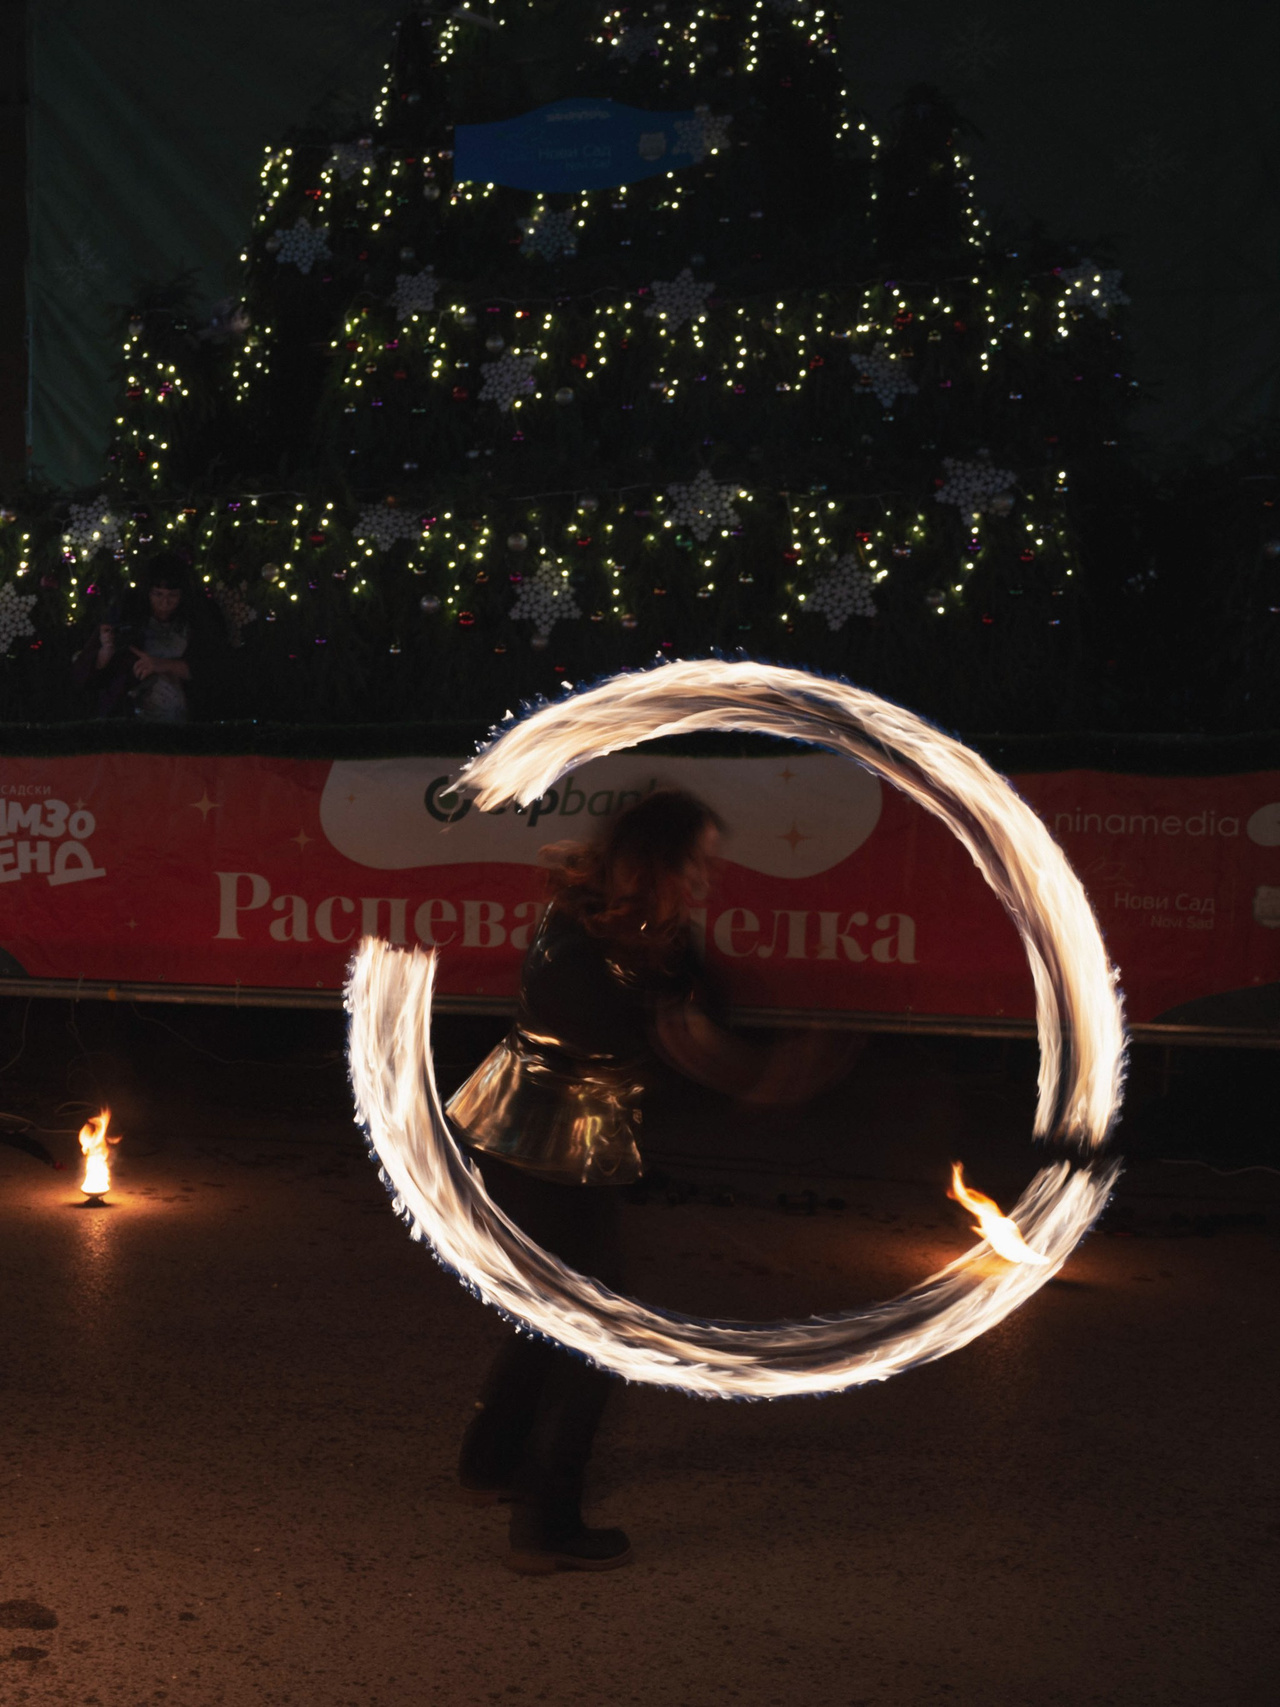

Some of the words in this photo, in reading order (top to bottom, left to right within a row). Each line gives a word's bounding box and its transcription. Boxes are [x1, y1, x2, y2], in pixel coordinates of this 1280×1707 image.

[1054, 807, 1240, 836] ninamedia
[211, 871, 555, 950] Распева
[1114, 892, 1169, 911] Нови
[1175, 893, 1216, 915] Сад
[1151, 915, 1183, 929] Novi
[1187, 916, 1215, 930] Sad
